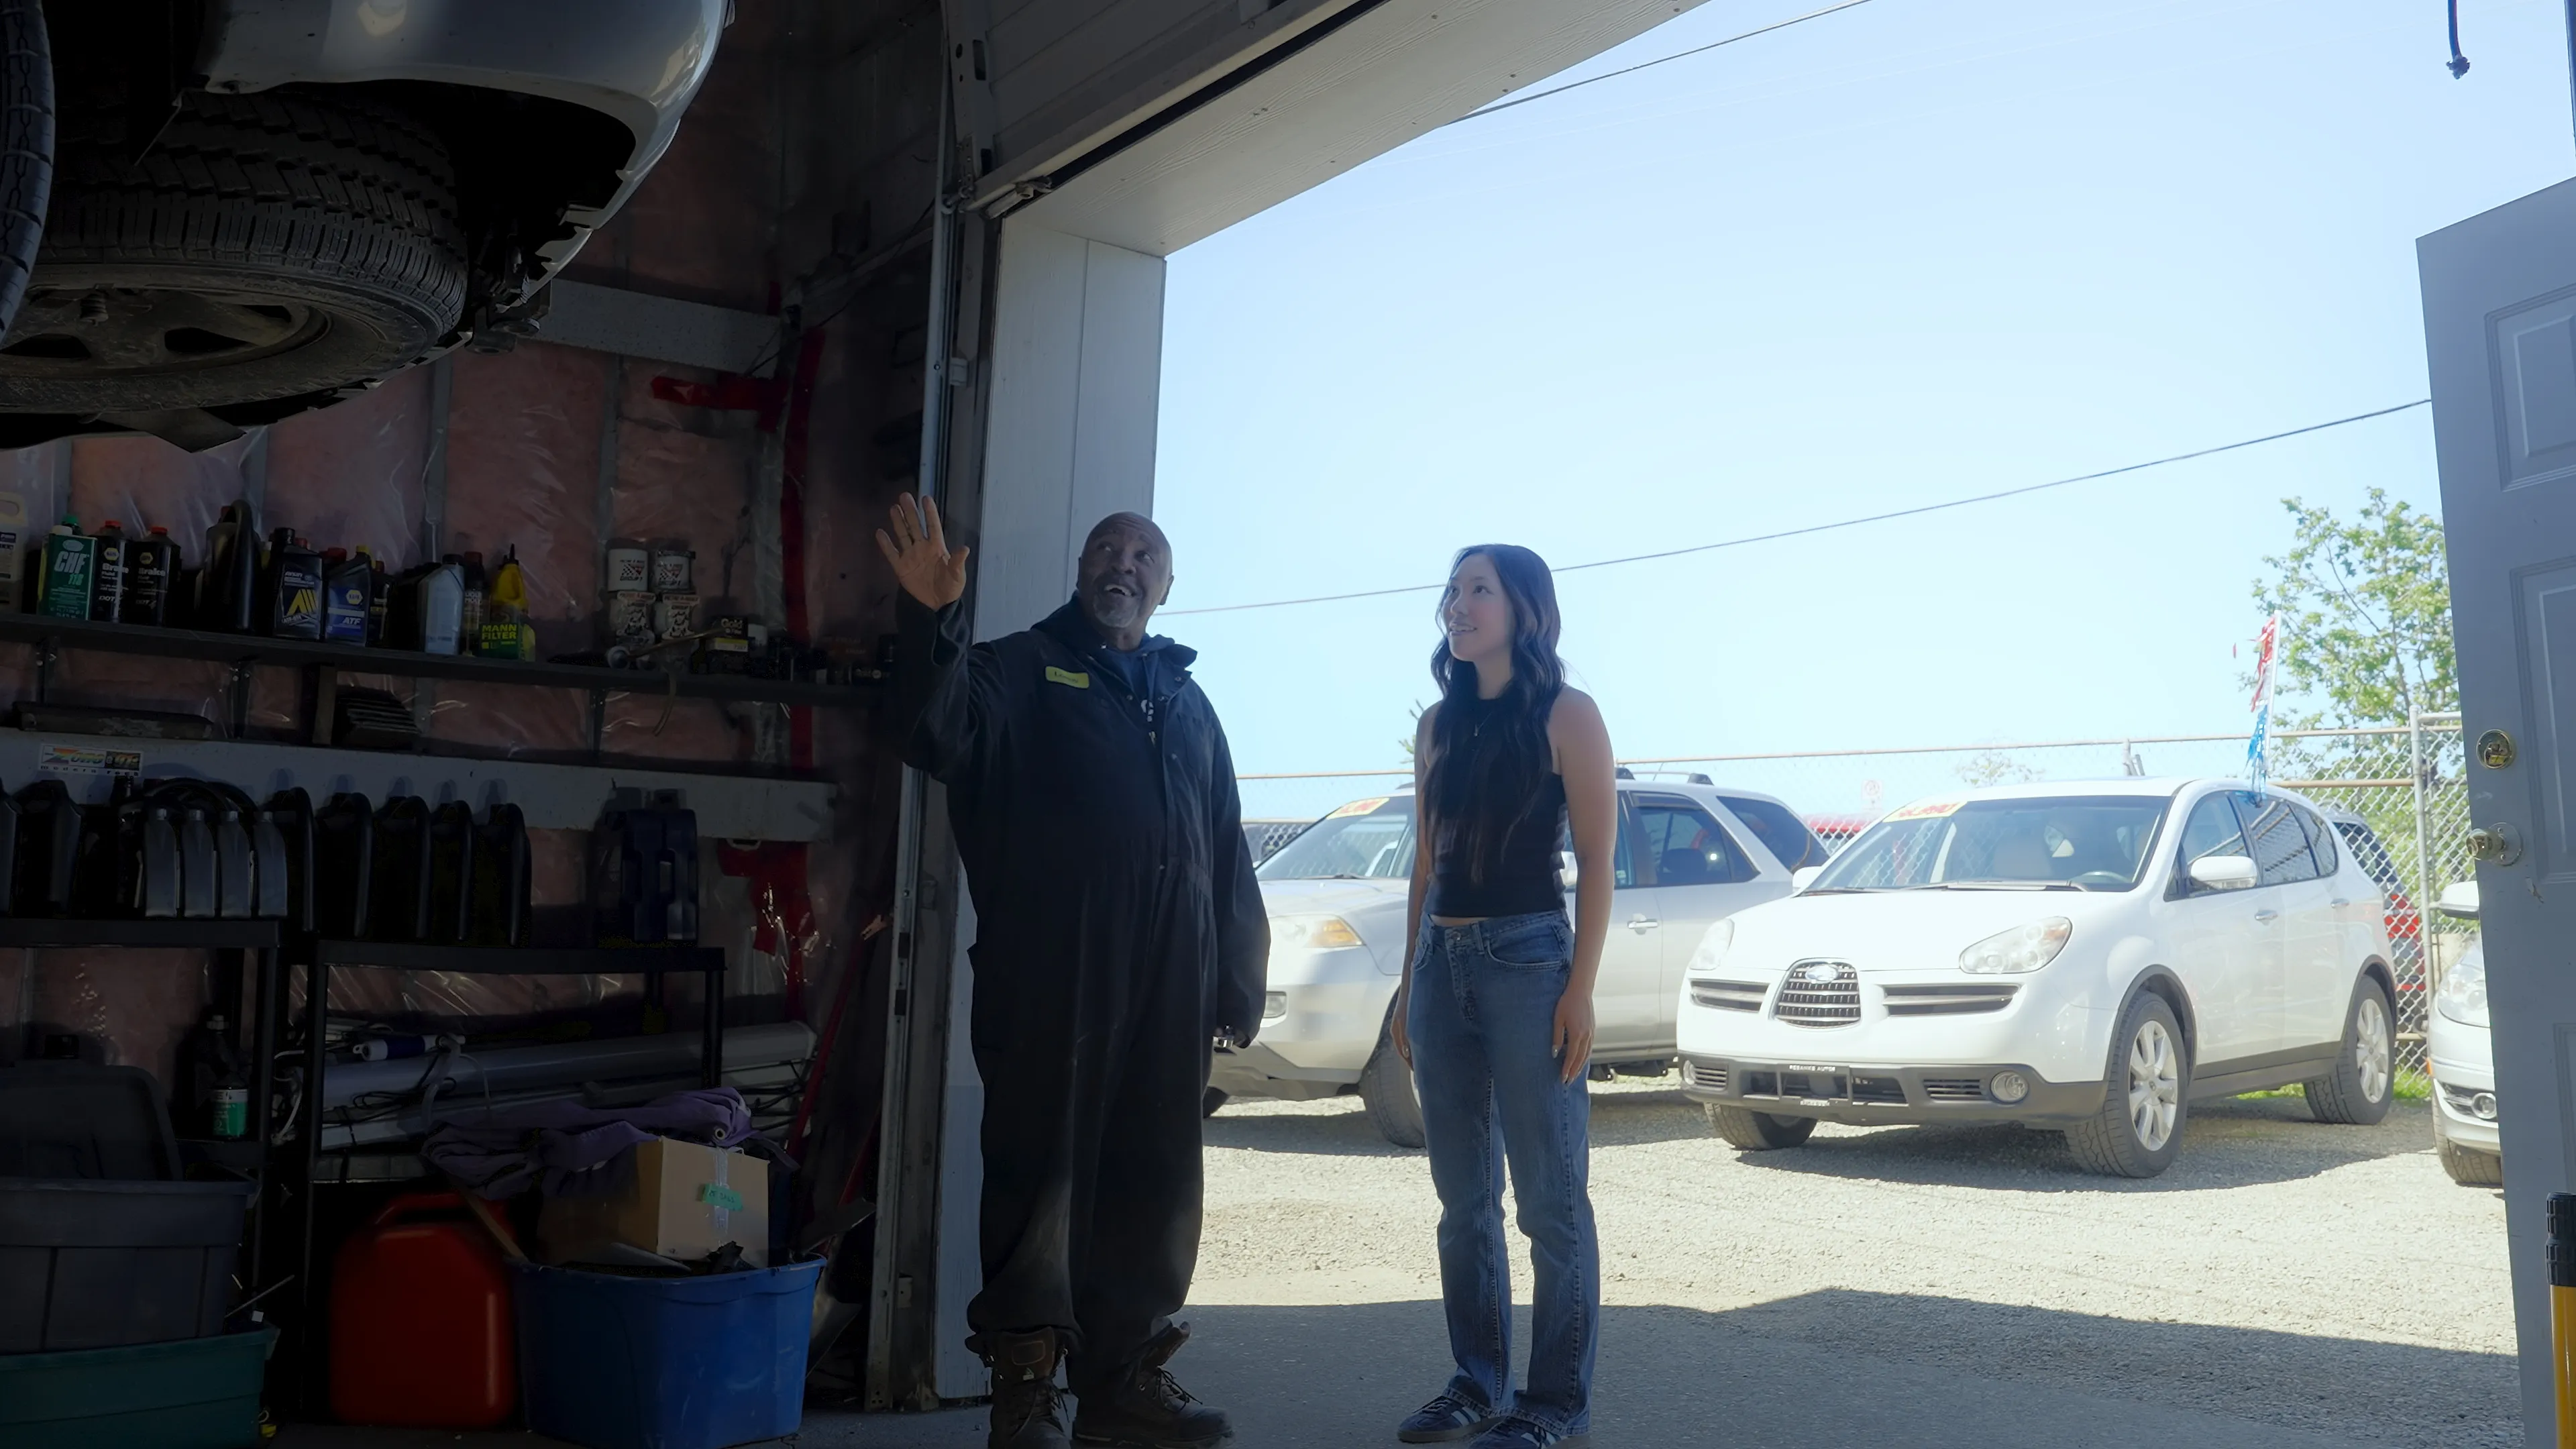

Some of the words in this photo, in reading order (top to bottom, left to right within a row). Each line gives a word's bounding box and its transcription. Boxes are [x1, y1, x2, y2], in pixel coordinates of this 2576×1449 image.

[54, 550, 87, 574] CHF
[138, 568, 166, 577] Brake
[342, 617, 362, 626] ATF
[721, 618, 743, 629] Gold
[482, 624, 517, 632] MANN
[482, 632, 517, 640] FILTER
